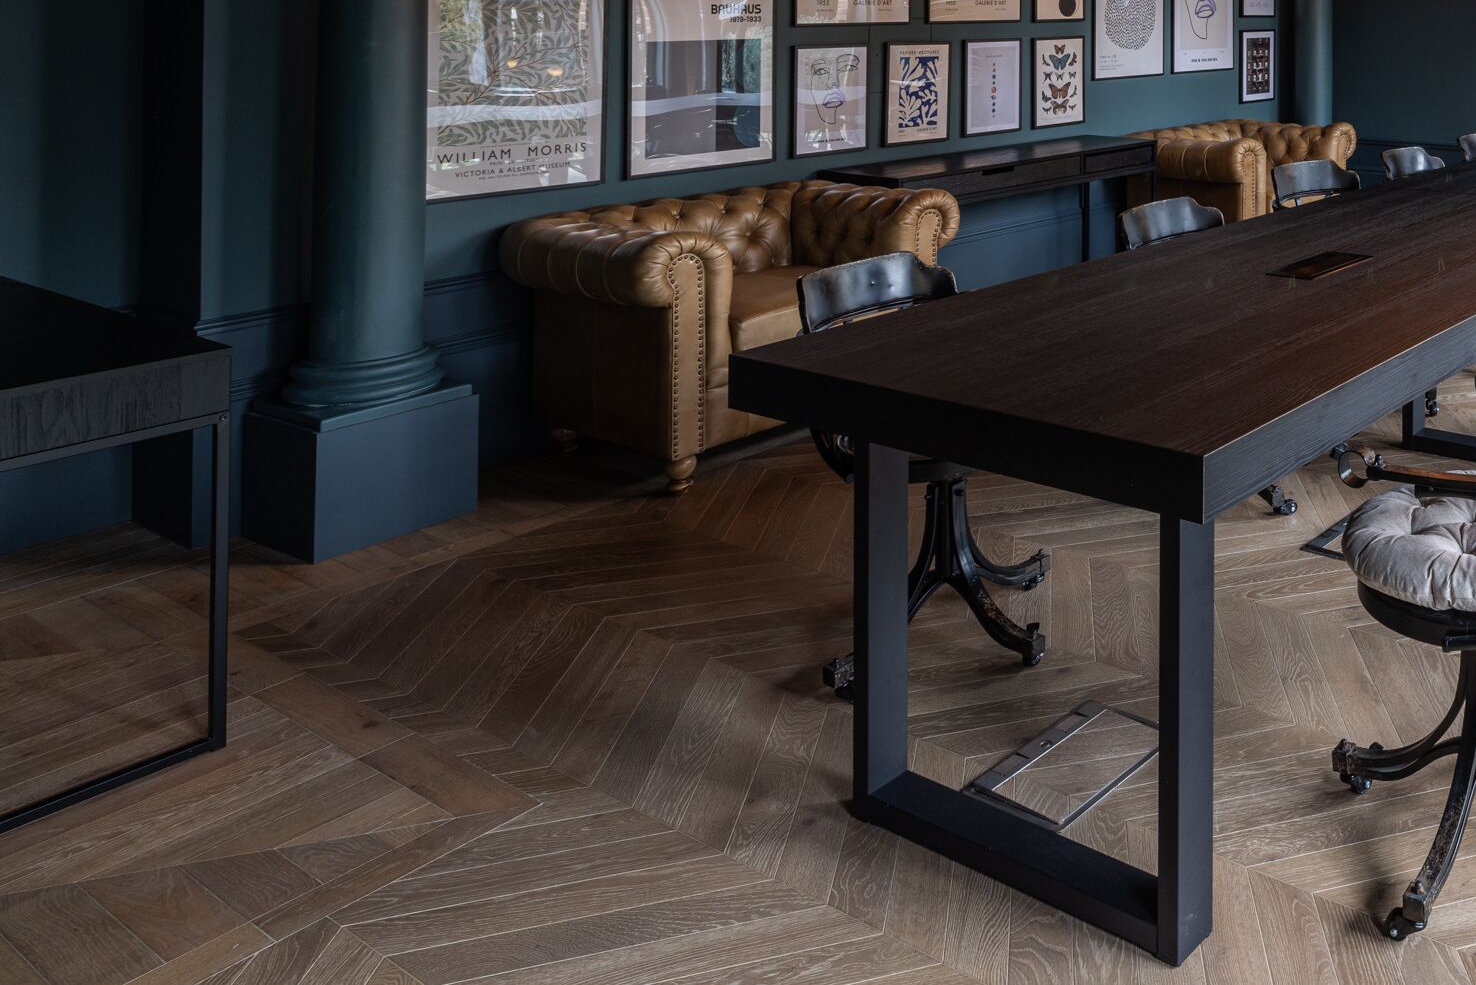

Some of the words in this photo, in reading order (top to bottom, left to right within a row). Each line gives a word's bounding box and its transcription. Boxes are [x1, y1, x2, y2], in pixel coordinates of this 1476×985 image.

[711, 4, 762, 15] BAUHAUS
[729, 15, 762, 23] 1919-1933
[437, 148, 512, 164] WILLIAM
[527, 142, 588, 158] MORRIS
[455, 169, 495, 178] VICTORIA
[507, 164, 536, 173] ALBERT
